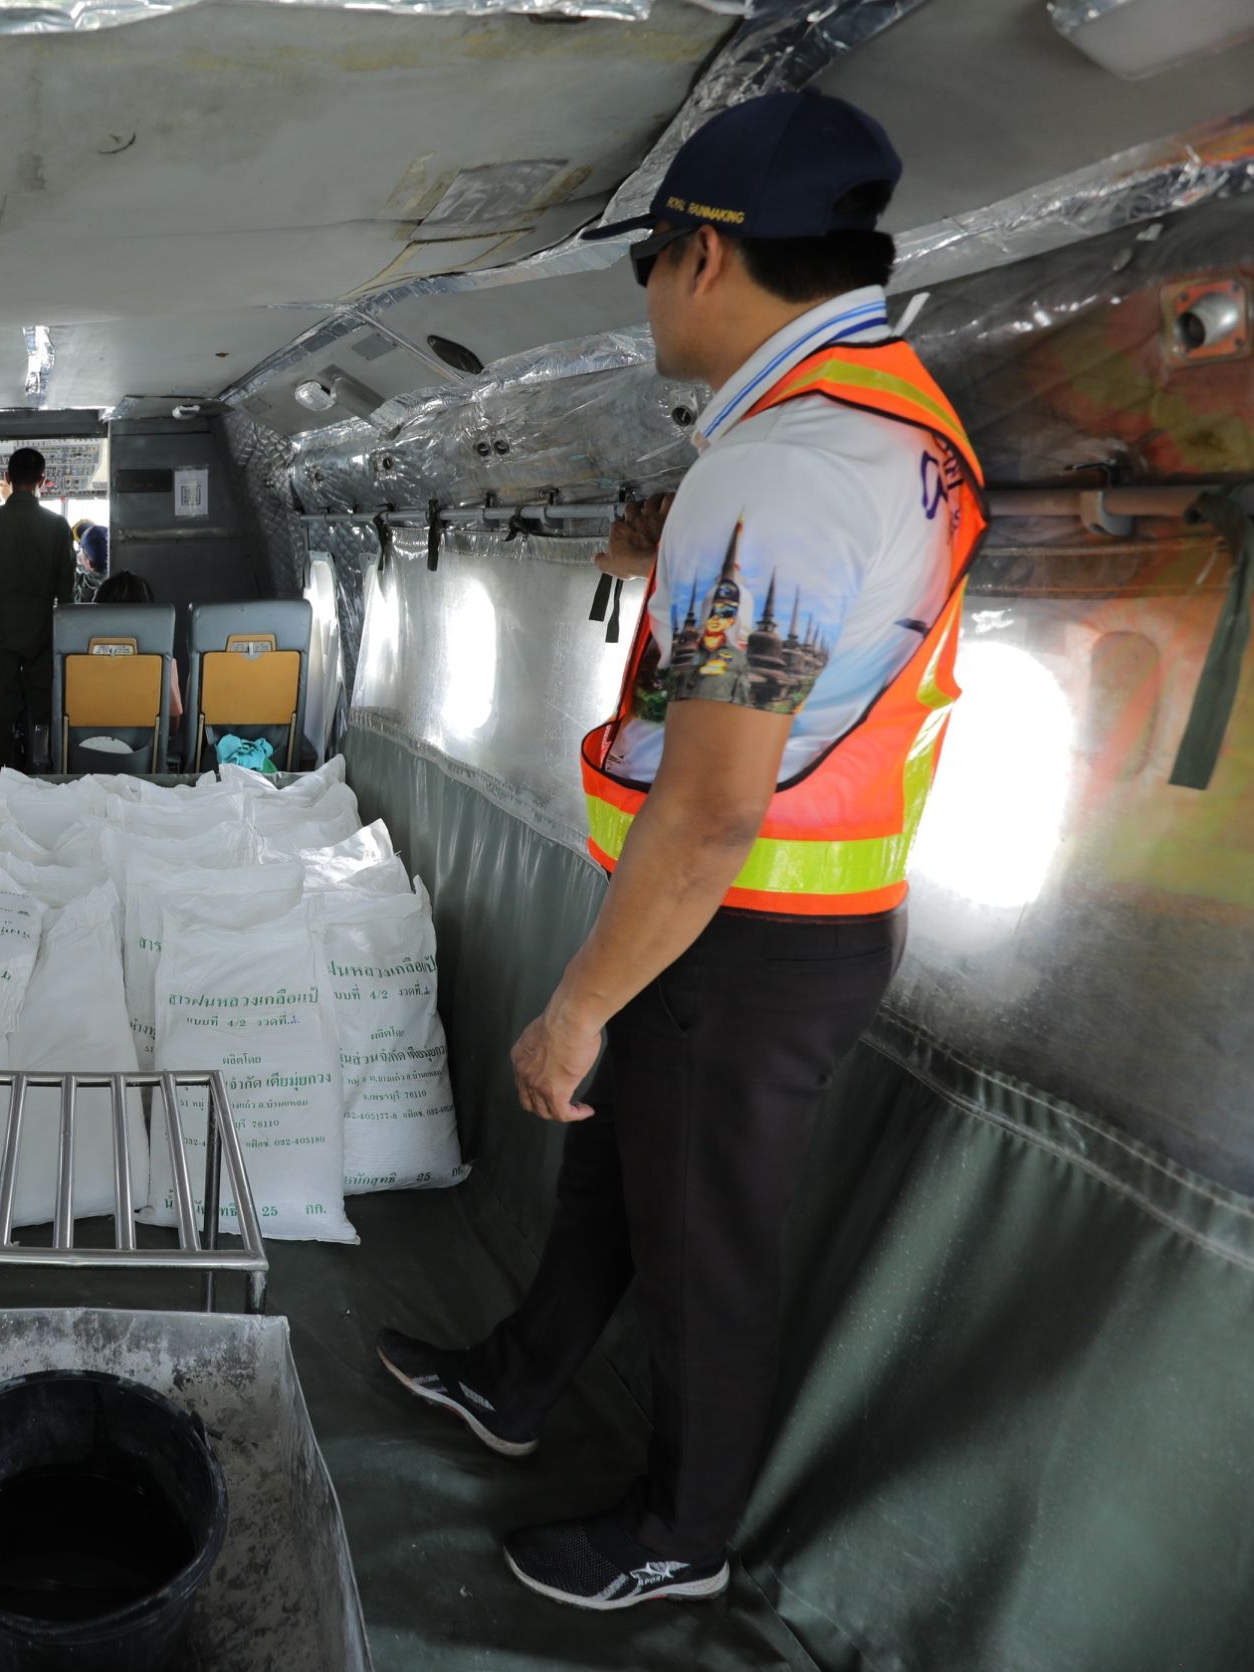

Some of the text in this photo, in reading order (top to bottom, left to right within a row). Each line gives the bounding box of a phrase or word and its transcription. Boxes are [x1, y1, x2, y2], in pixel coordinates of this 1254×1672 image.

[687, 202, 745, 224] RAINMAKING
[168, 986, 320, 1008] สารฝนหลวงเกลือแป้
[227, 1019, 247, 1027] 4/2
[222, 1052, 262, 1066] ผลิตโดย
[250, 1119, 281, 1129] 76110
[261, 1205, 279, 1217] 25
